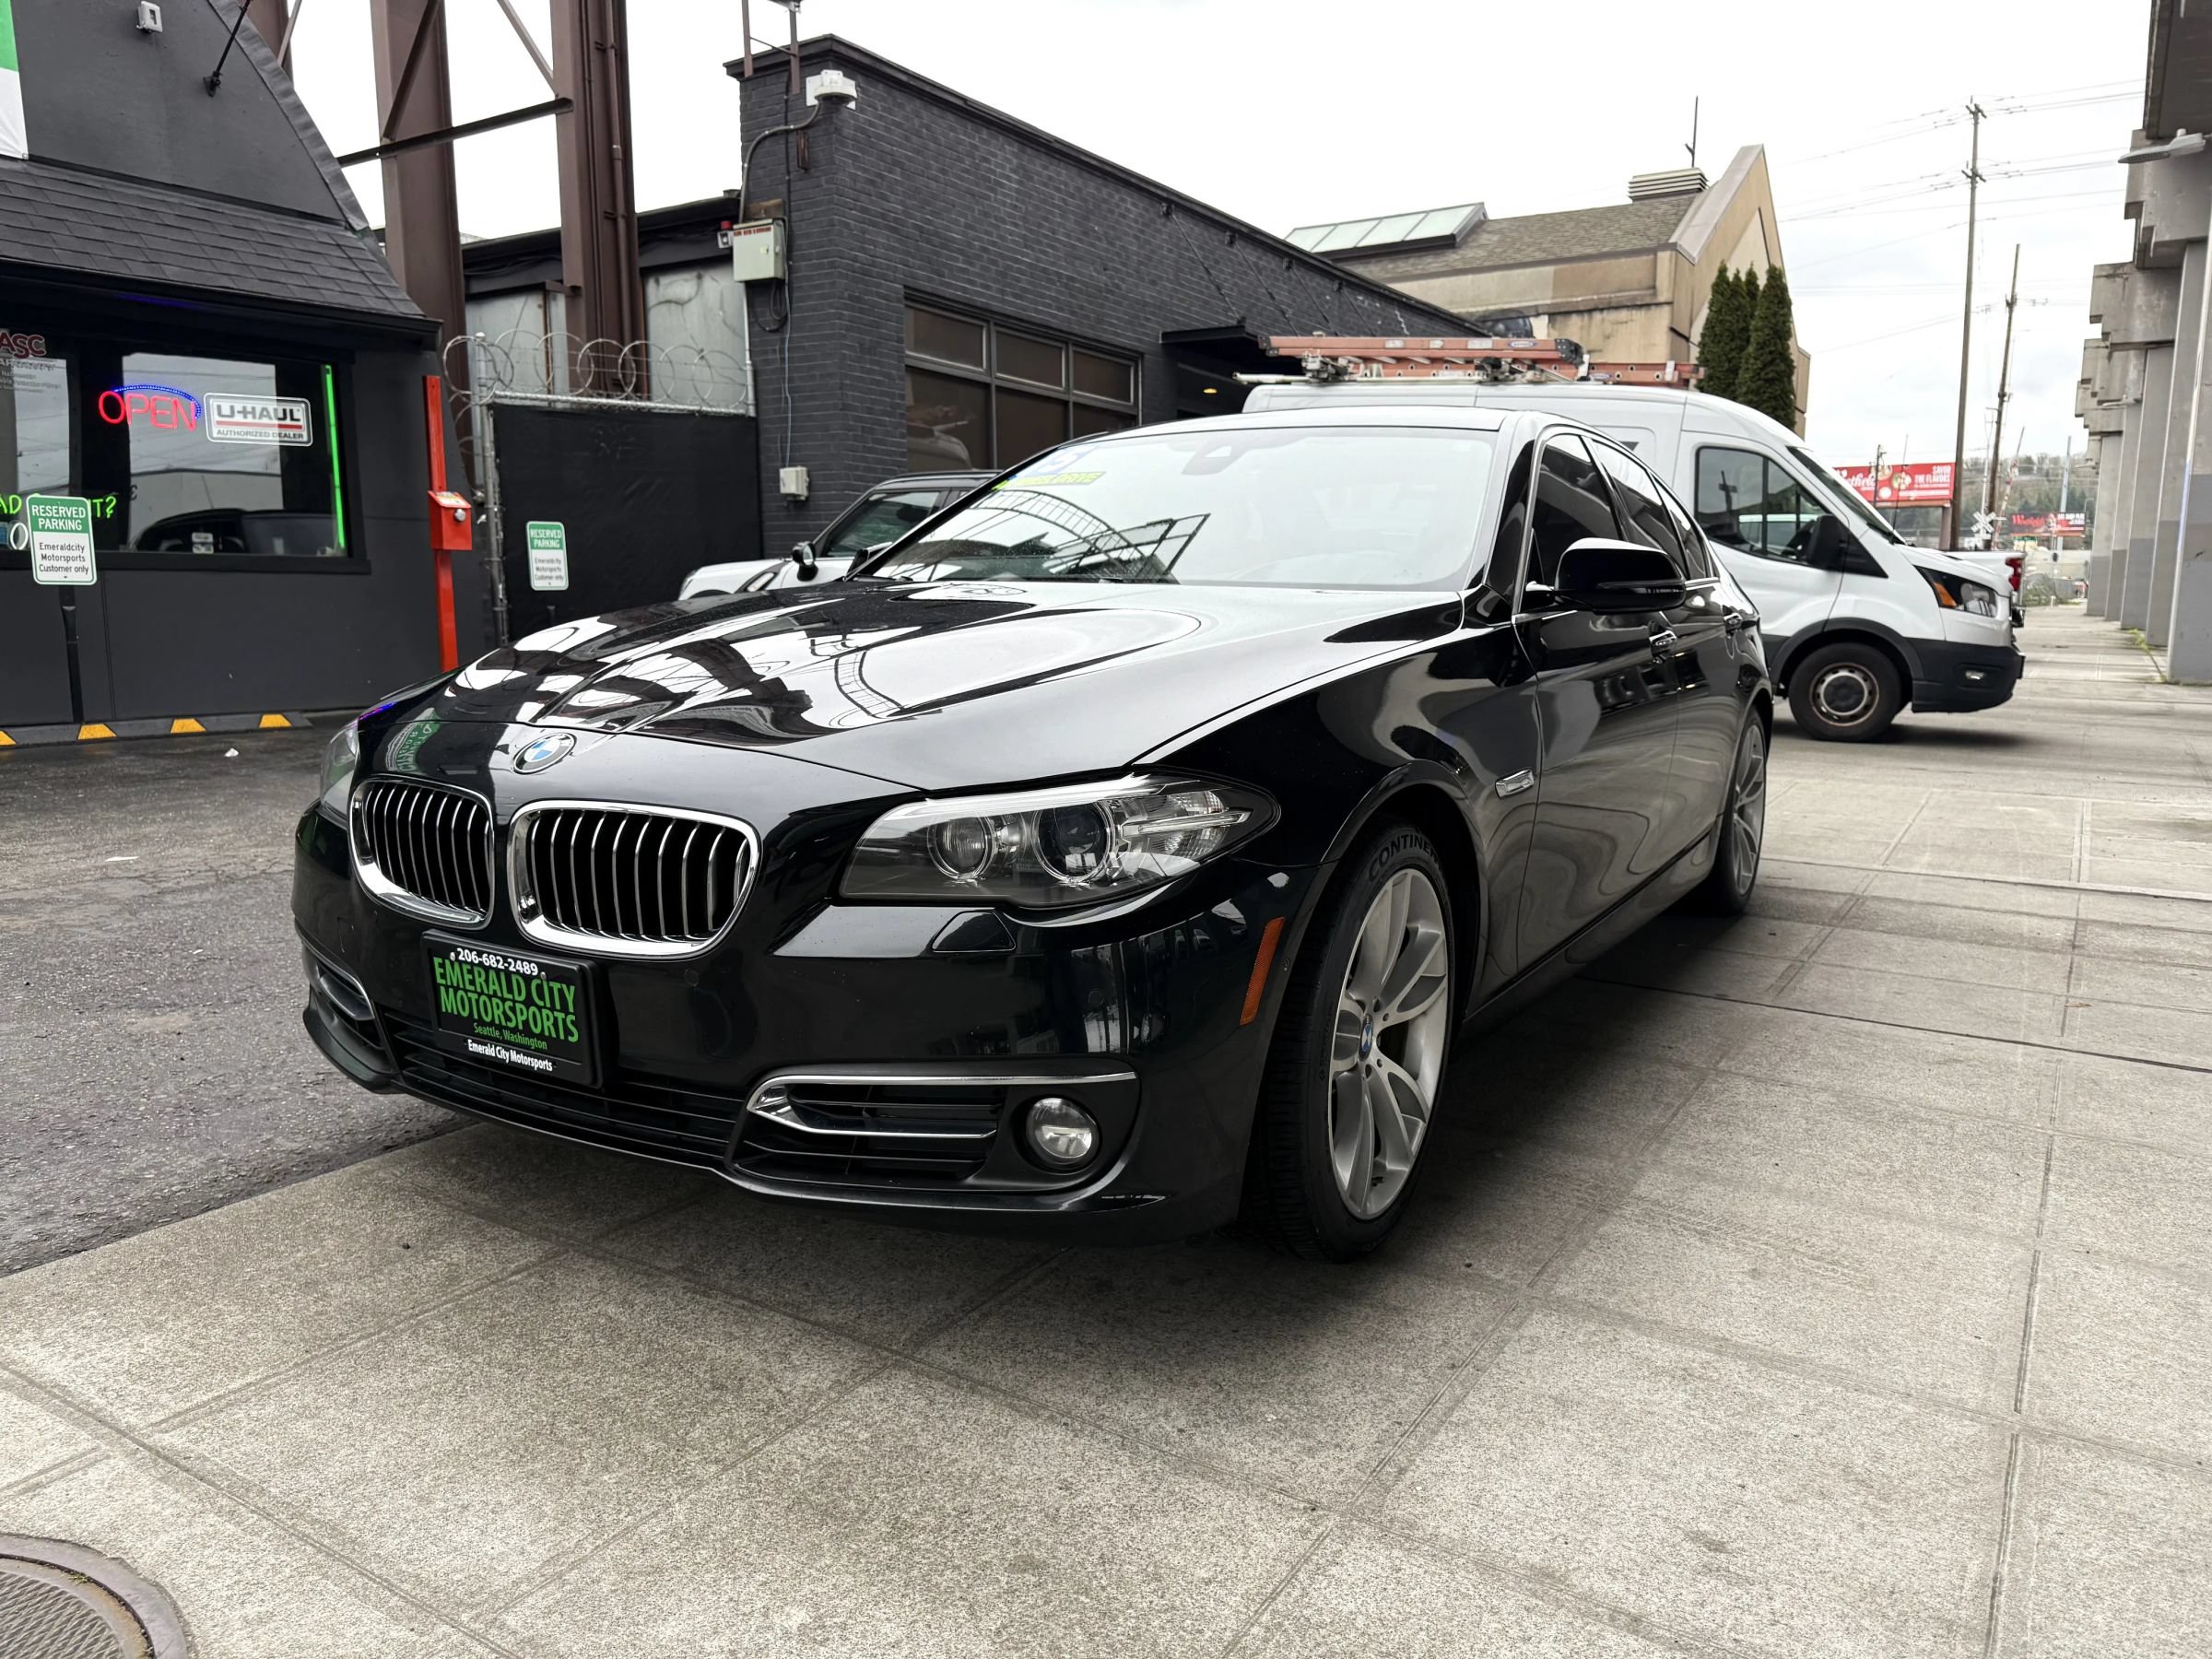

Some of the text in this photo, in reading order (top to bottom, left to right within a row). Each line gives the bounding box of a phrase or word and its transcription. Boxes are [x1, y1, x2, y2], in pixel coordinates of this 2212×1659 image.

[98, 390, 197, 432] OPEN
[216, 404, 300, 422] U-HAUL
[217, 429, 304, 441] AUTHORIZED DEALER
[31, 505, 86, 518] RESERVED
[38, 518, 82, 531] PARKING
[530, 529, 562, 539] RESERVED
[39, 542, 85, 553] Emeraldcity
[535, 538, 560, 548] PARKING
[41, 554, 86, 564] Motorsports
[39, 564, 89, 575] Customer only
[457, 947, 539, 976] 206-682-2489
[433, 957, 576, 1013] EMERALD CITY
[440, 985, 579, 1042] MOTORSPORTS
[473, 1022, 547, 1050] Seattle, Washington
[467, 1039, 553, 1072] Emerald City Motorsports
